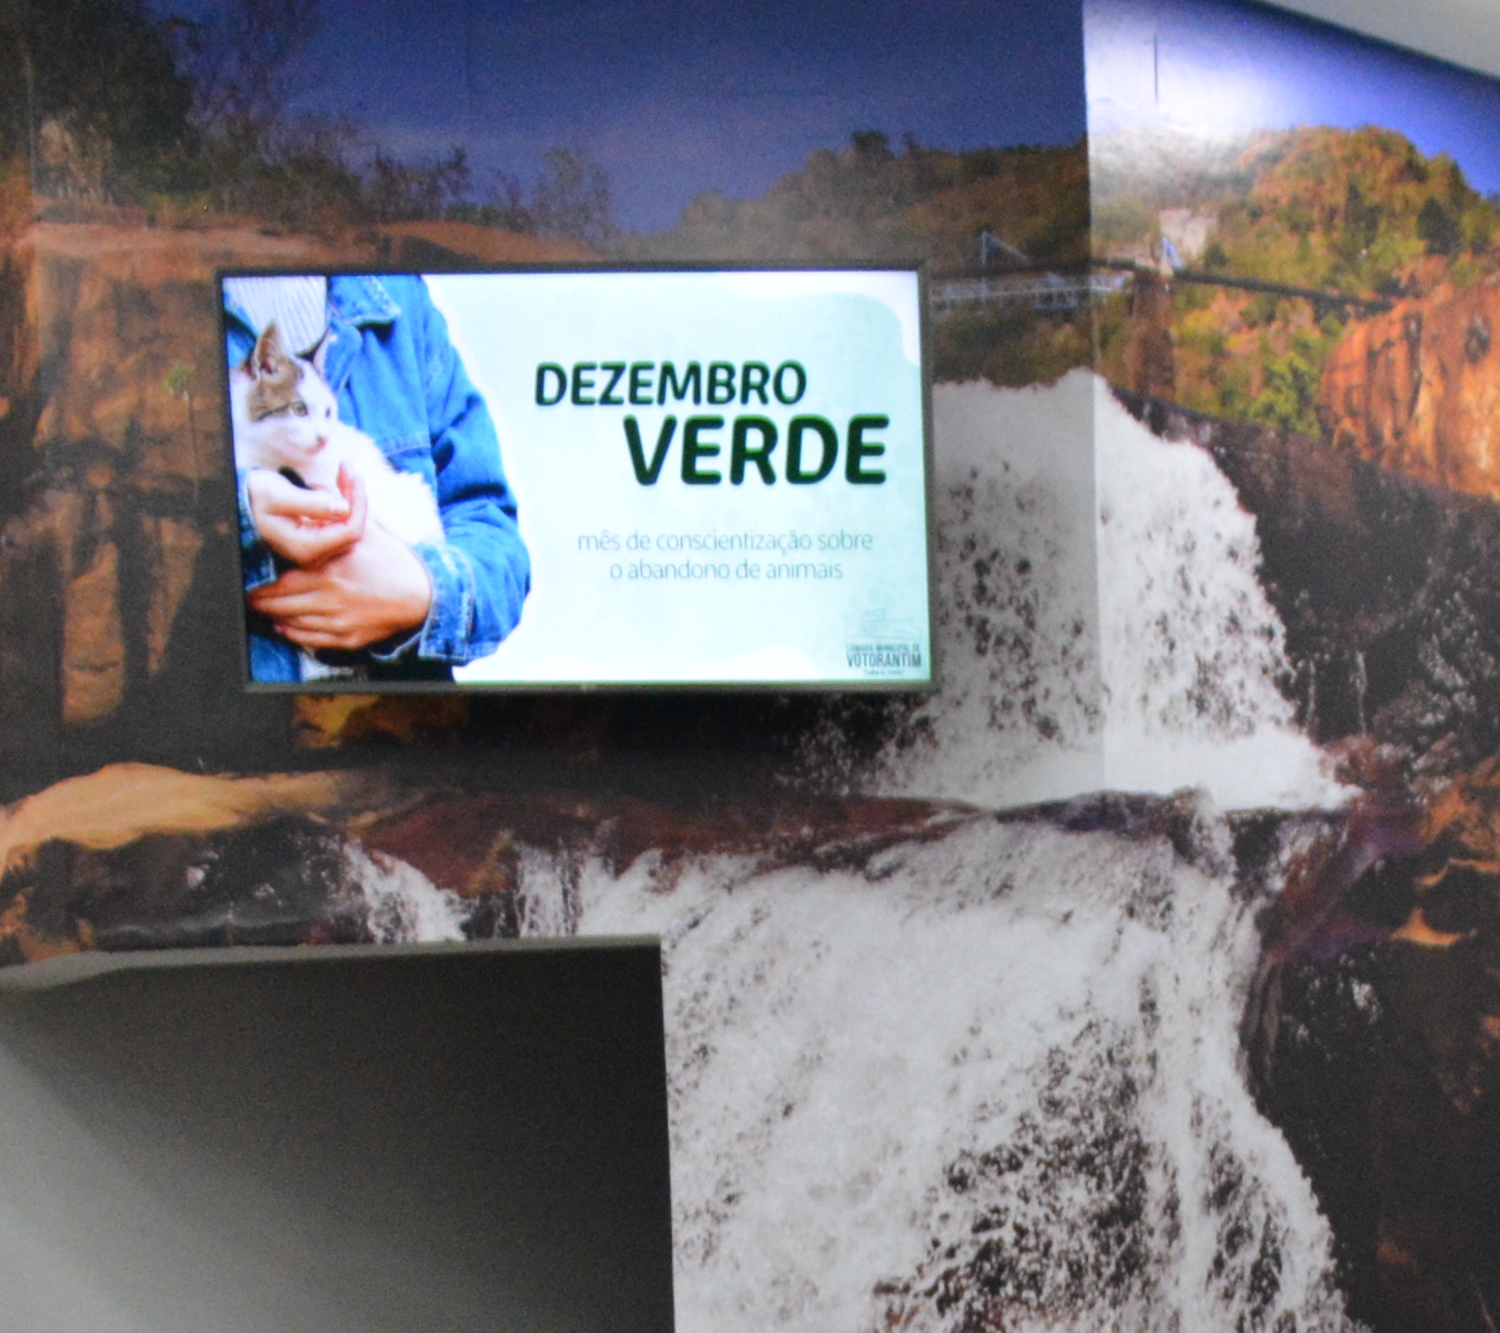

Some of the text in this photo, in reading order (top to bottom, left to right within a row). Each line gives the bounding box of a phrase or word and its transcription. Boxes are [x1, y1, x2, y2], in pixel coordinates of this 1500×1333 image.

[535, 360, 807, 407] DEZEMBRO
[623, 413, 890, 487] VERDE
[578, 528, 873, 555] mês de conscientização sobre
[610, 558, 843, 580] o abandono de animais
